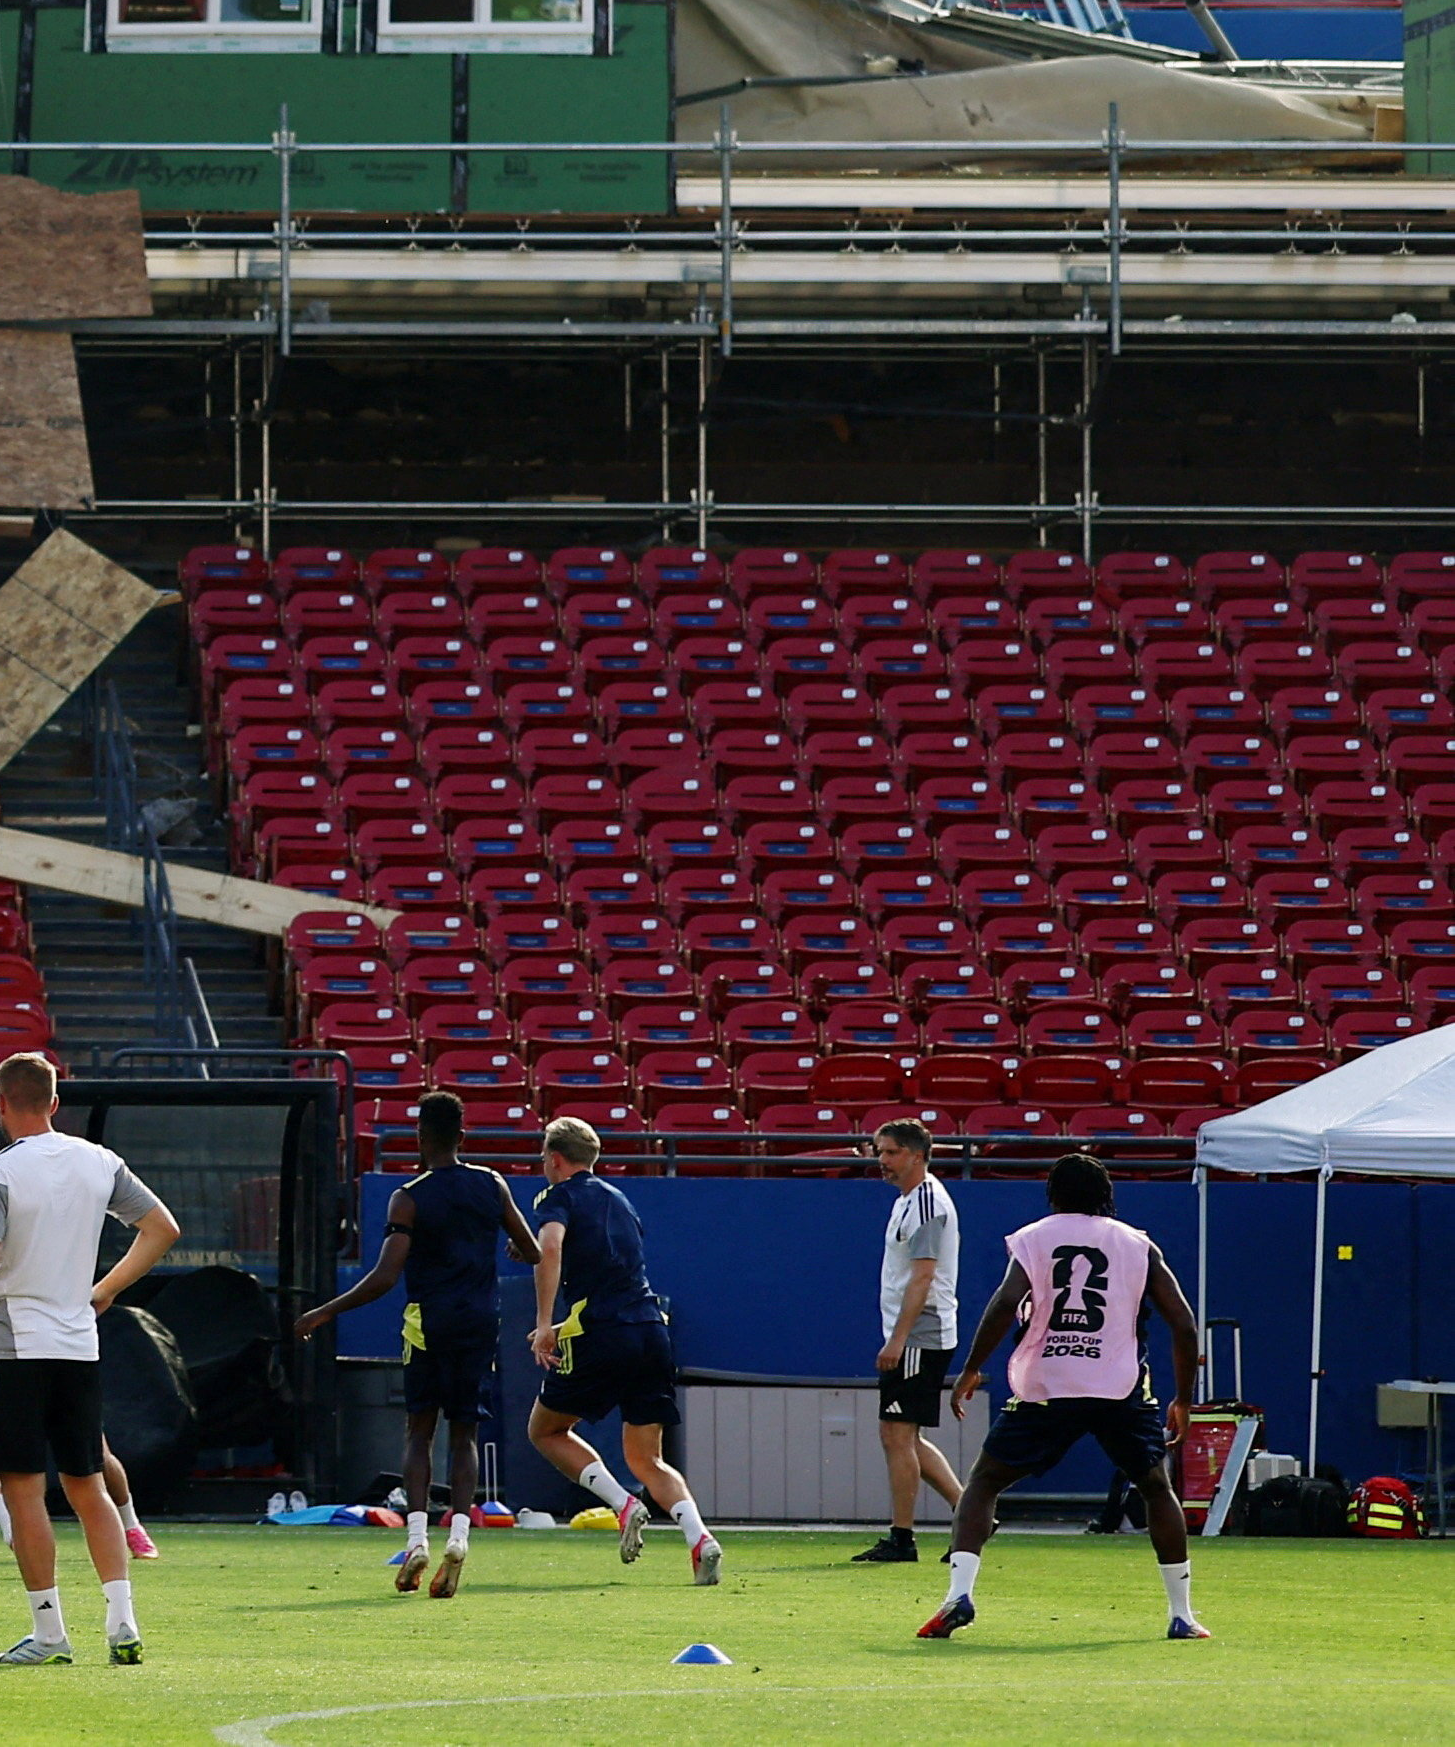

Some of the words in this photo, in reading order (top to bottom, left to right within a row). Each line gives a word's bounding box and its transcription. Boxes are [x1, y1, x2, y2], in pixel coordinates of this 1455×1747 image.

[1060, 1313, 1089, 1326] FIFA
[1081, 1335, 1102, 1346] CUP
[1041, 1344, 1101, 1359] 2026
